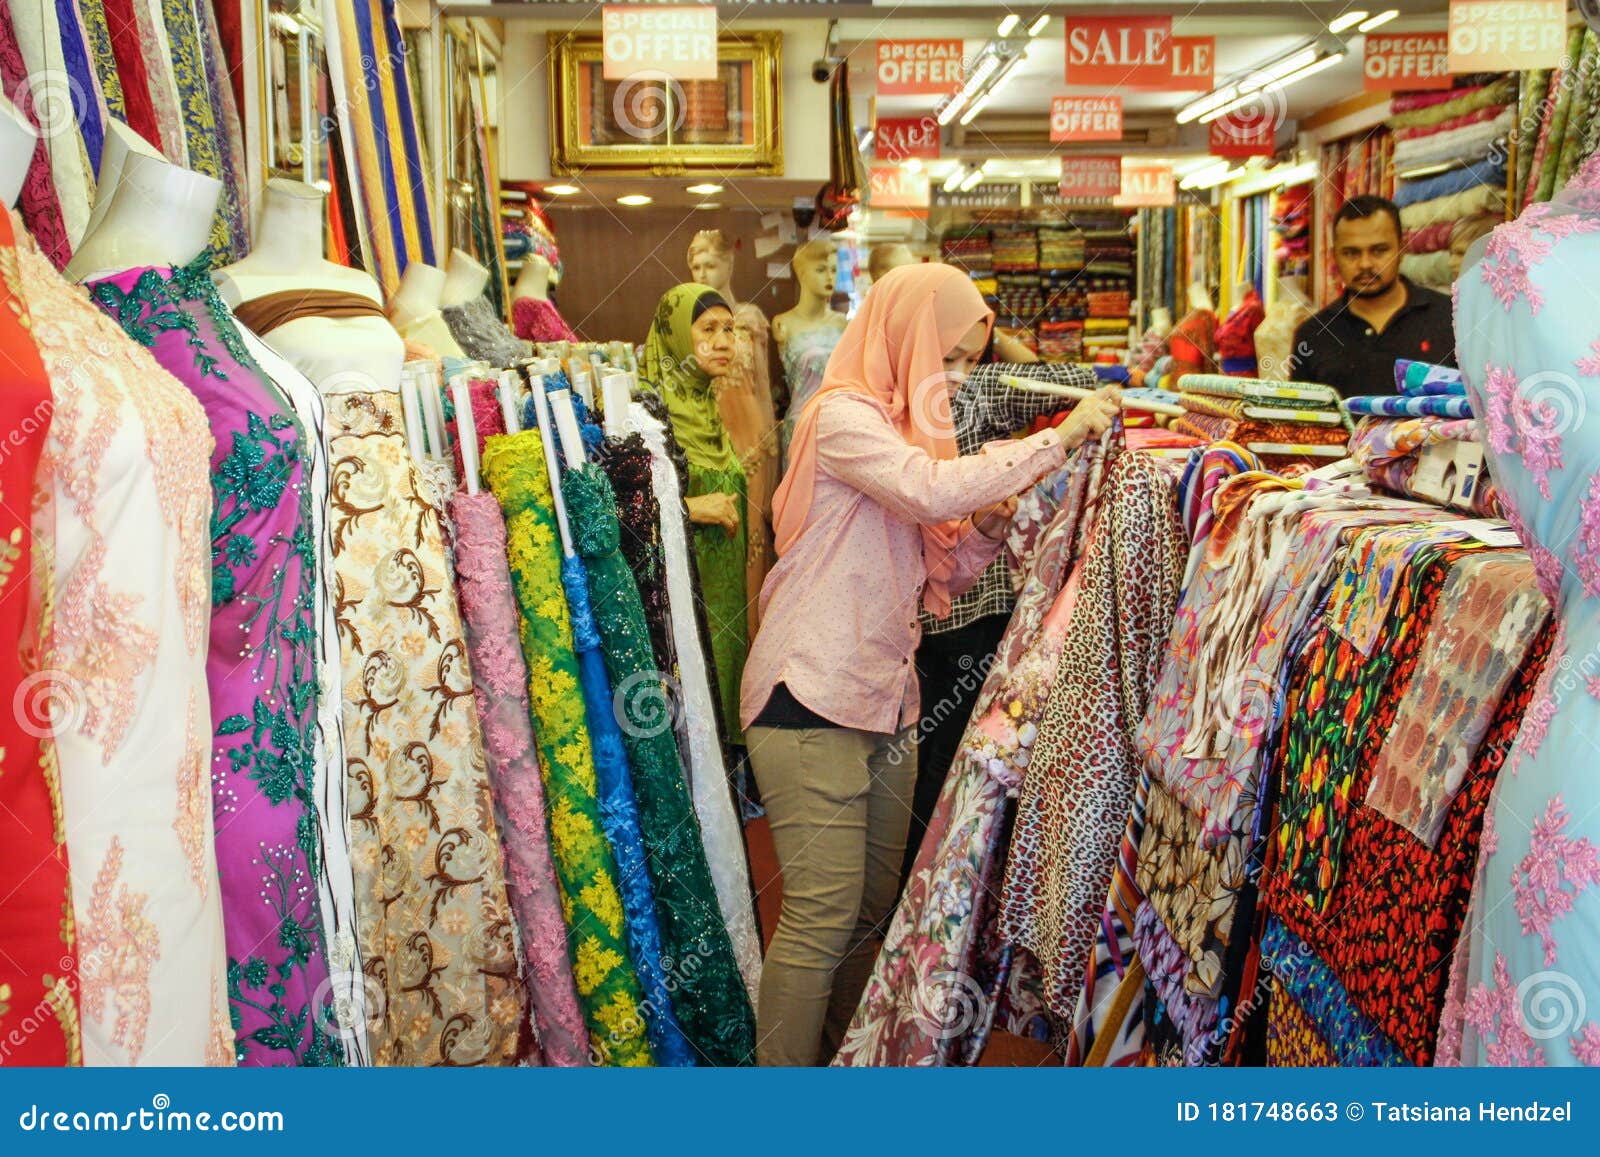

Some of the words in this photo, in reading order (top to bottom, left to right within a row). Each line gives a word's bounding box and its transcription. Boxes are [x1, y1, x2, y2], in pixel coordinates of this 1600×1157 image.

[606, 12, 711, 31] SPECIAL
[1453, 4, 1559, 24] SPECIAL
[606, 33, 712, 62] OFFER
[1069, 27, 1166, 65] SALE
[1367, 38, 1449, 54] SPECIAL
[1453, 25, 1560, 55] OFFER
[879, 43, 959, 59] SPECIAL
[1172, 44, 1211, 76] LE
[878, 60, 961, 85] OFFER
[1365, 55, 1450, 79] OFFER
[1053, 100, 1118, 112] SPECIAL
[1052, 112, 1119, 132] OFFER
[877, 126, 937, 148] SALE
[1064, 160, 1118, 171] SPECIAL
[1062, 171, 1119, 189] OFFER
